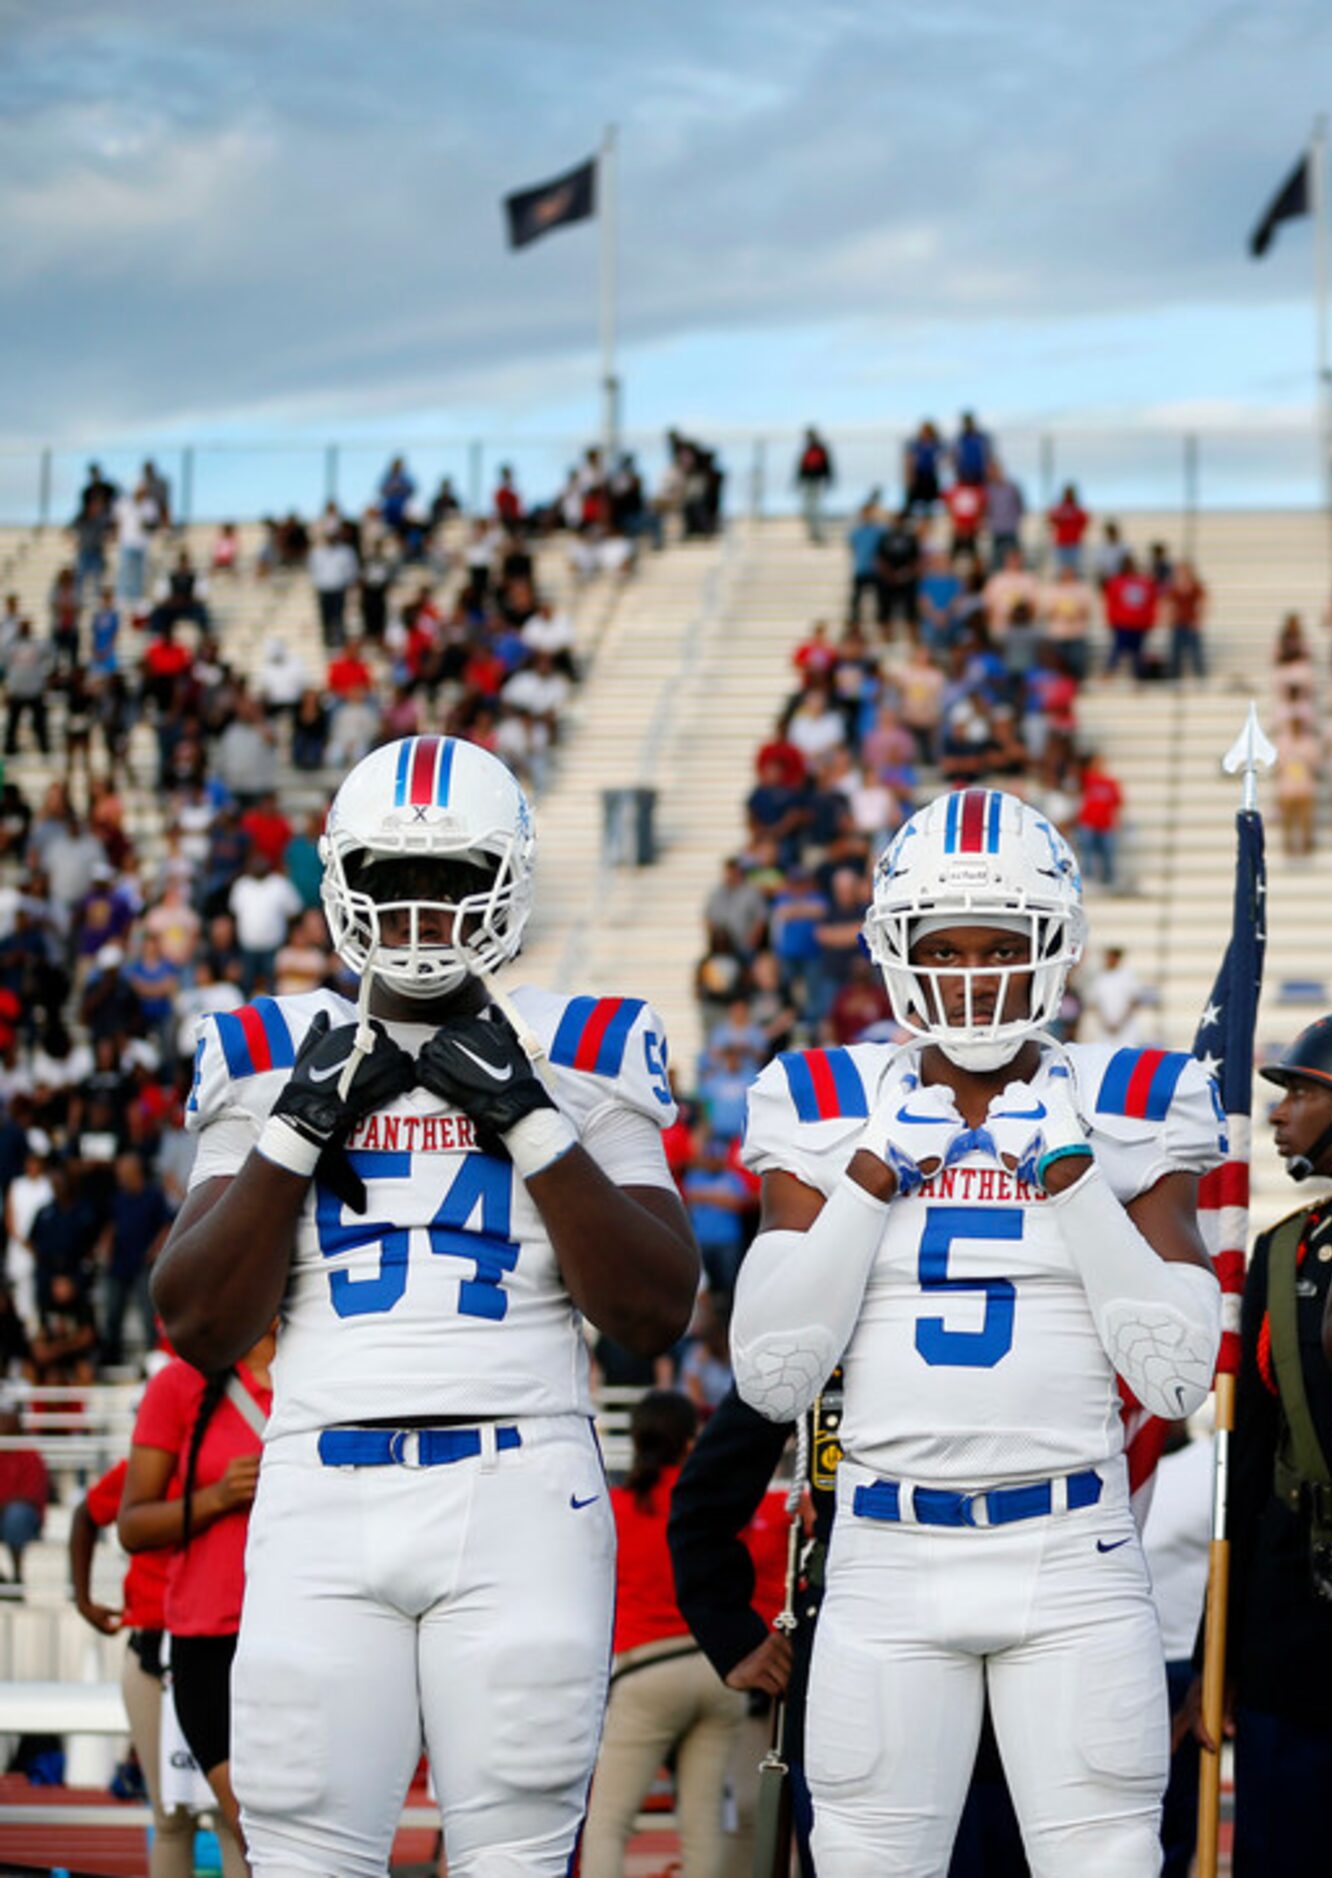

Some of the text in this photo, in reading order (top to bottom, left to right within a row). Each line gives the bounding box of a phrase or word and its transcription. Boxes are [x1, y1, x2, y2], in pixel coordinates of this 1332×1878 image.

[346, 1115, 477, 1151] PANTHER
[315, 1151, 521, 1322] 54
[914, 1206, 1024, 1368] 5
